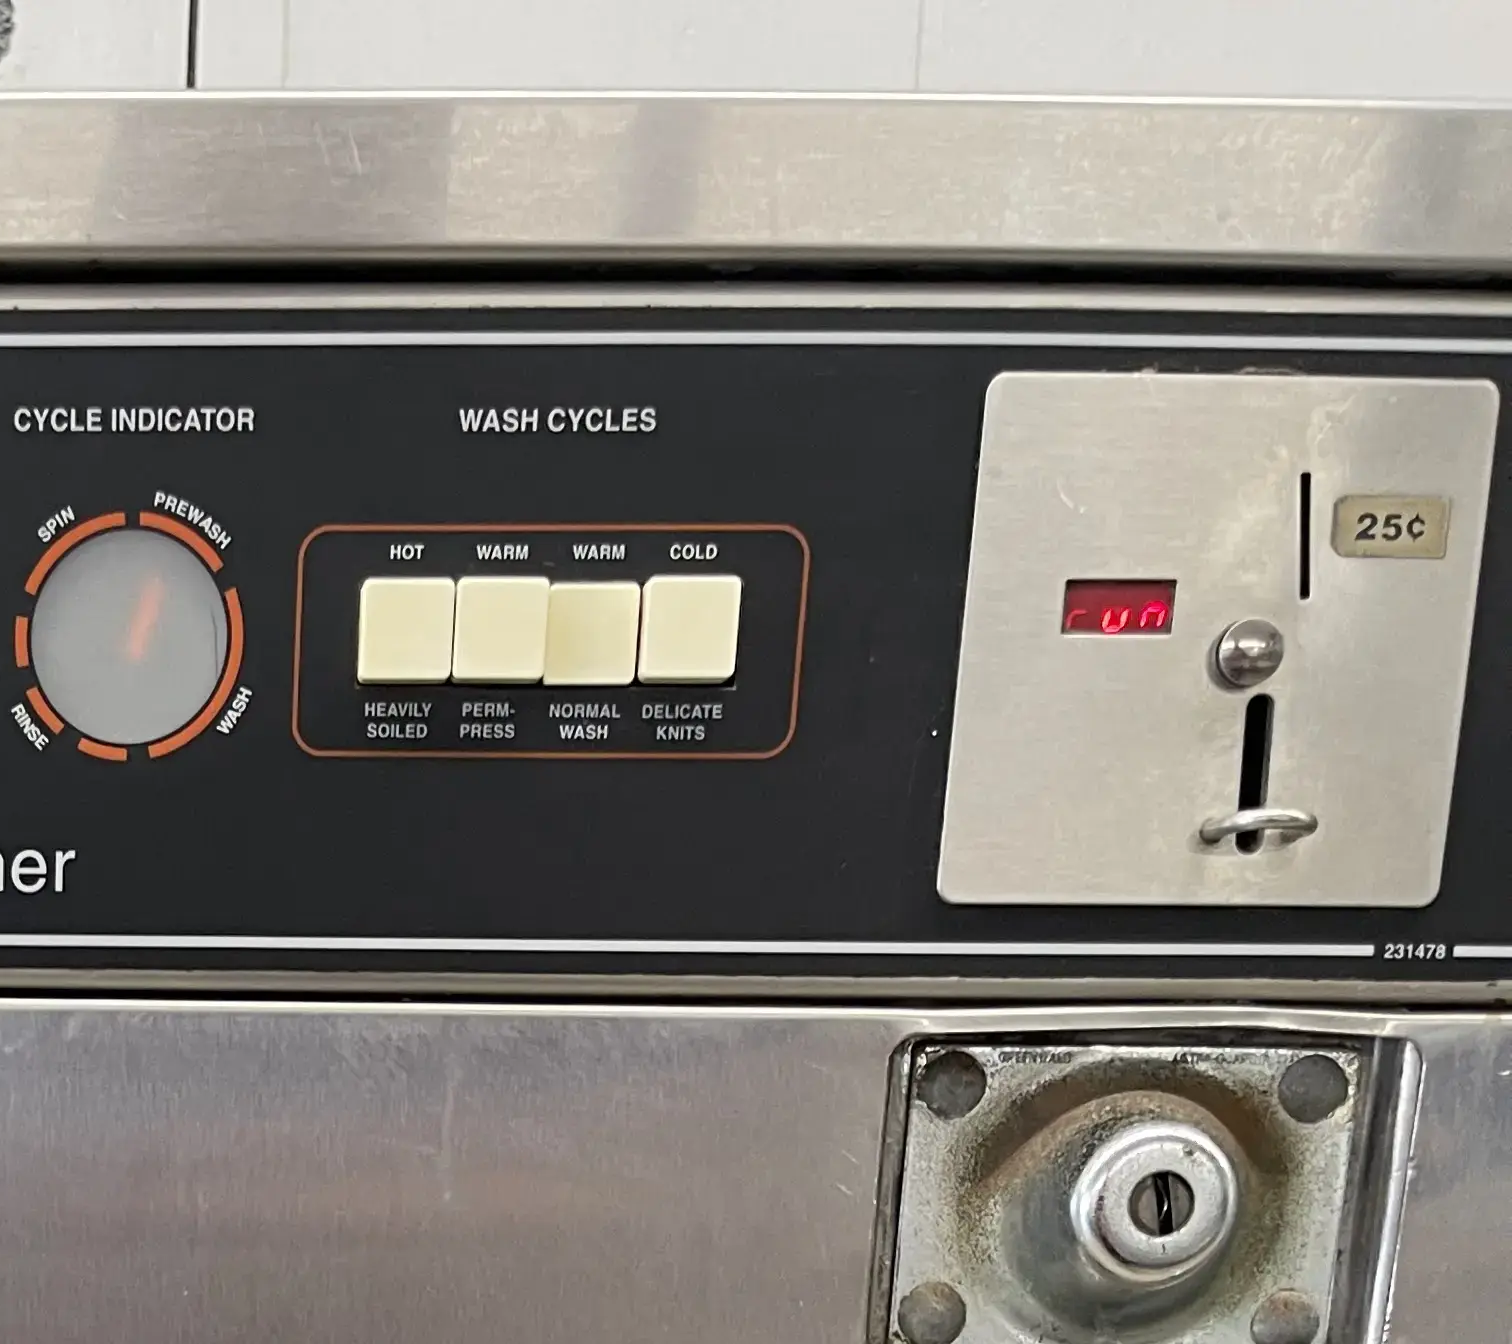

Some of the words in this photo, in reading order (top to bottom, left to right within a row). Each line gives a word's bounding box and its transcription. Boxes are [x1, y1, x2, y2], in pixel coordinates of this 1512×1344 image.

[14, 409, 102, 432] CYCLE
[111, 409, 255, 432] INDICATOR
[459, 408, 539, 433] WASH
[547, 408, 657, 433] CYCLES
[37, 506, 76, 544] SPIN
[154, 492, 232, 550] PREWASH
[1354, 512, 1426, 543] 25¢
[390, 545, 424, 560] HOT
[476, 545, 529, 560] WARM
[572, 546, 625, 561] WARM
[670, 545, 717, 560] COLD
[216, 687, 253, 736] WASH
[365, 702, 432, 718] HEAVILY
[462, 703, 516, 718] PERM-
[549, 704, 621, 720] NORMAL
[641, 704, 722, 720] DELICATE
[10, 704, 49, 751] RINSE
[367, 723, 428, 740] SOILED
[459, 724, 515, 740] PRESS
[559, 725, 608, 741] WASH
[656, 725, 706, 742] KNITS
[1384, 944, 1446, 960] 231478
